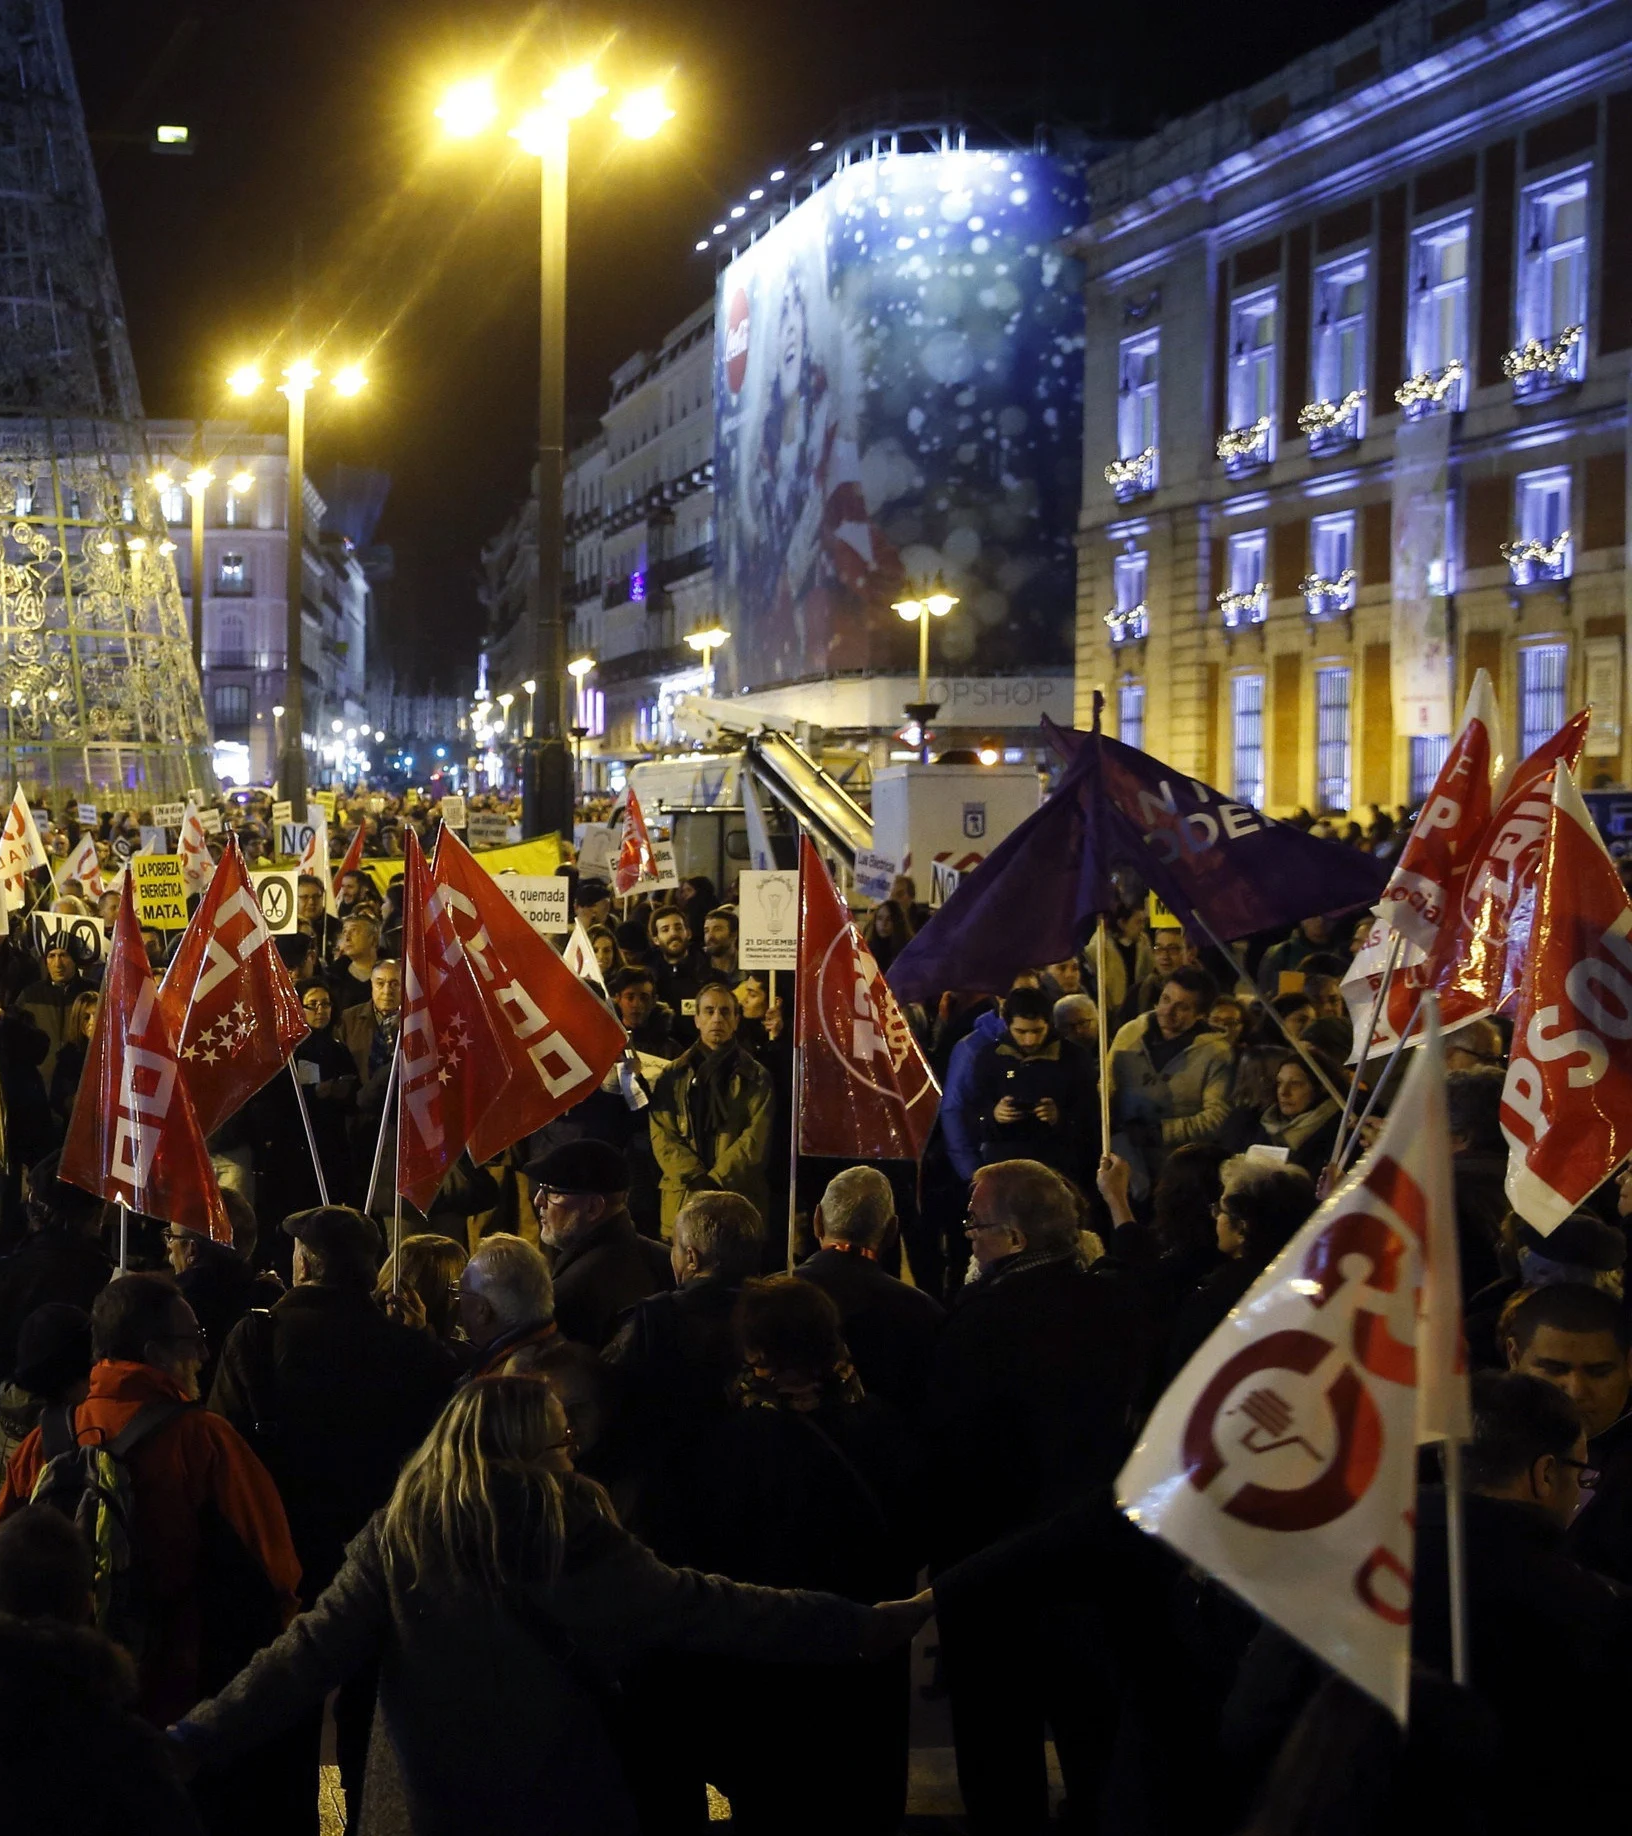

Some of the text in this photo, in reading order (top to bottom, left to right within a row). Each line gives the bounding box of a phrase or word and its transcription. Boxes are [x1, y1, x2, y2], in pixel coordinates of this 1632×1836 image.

[281, 825, 317, 855] NO
[138, 863, 147, 877] LA
[148, 860, 180, 877] POBREZA
[140, 879, 183, 899] ENERGÉTICA
[519, 889, 565, 905] quemada
[143, 903, 186, 920] MATA.
